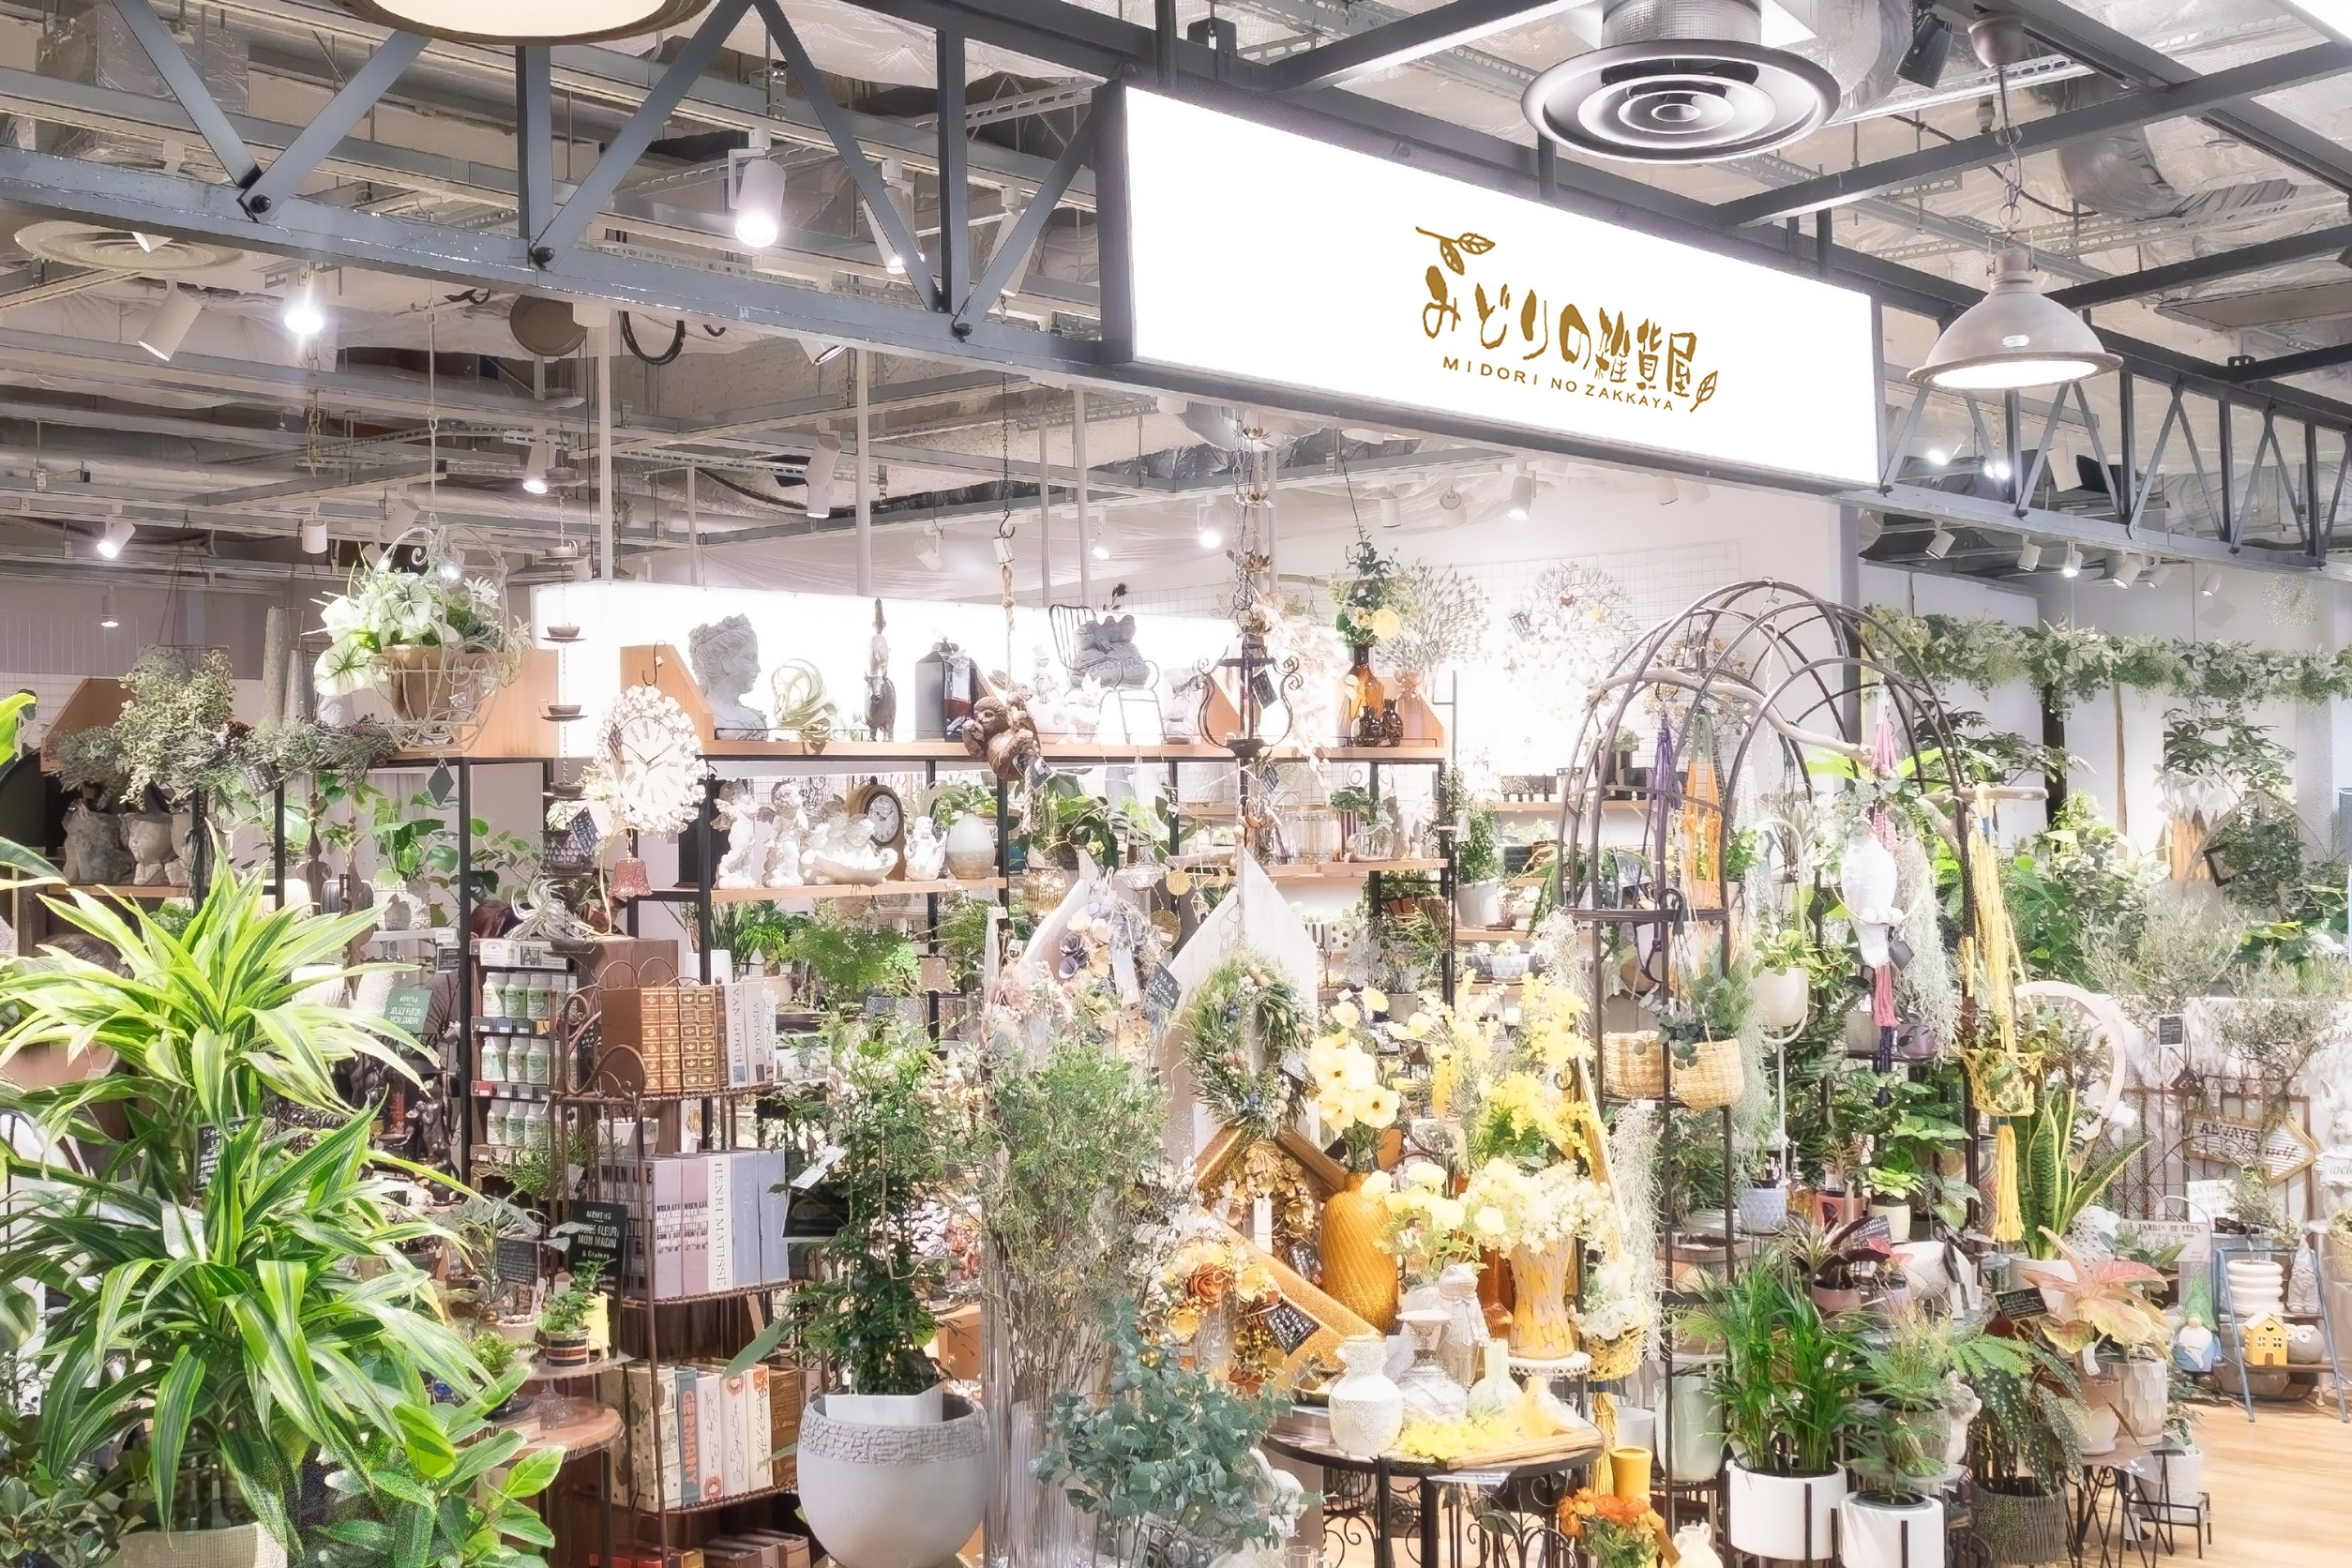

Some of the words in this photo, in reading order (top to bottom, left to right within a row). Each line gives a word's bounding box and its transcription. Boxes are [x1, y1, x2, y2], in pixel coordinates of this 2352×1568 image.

[1423, 265, 1696, 398] みどりの雑貨屋
[1443, 356, 1539, 386] MIDORI
[1550, 377, 1577, 393] NO
[1585, 384, 1674, 412] ZAKKAYA
[732, 988, 741, 1017] VAN
[753, 1002, 762, 1055] VINTAGE
[733, 1022, 743, 1063] GOGH
[601, 1165, 627, 1182] WEN
[714, 1163, 724, 1212] HENRI
[716, 1218, 727, 1287] MATISSE
[683, 1390, 698, 1485] GERMANY
